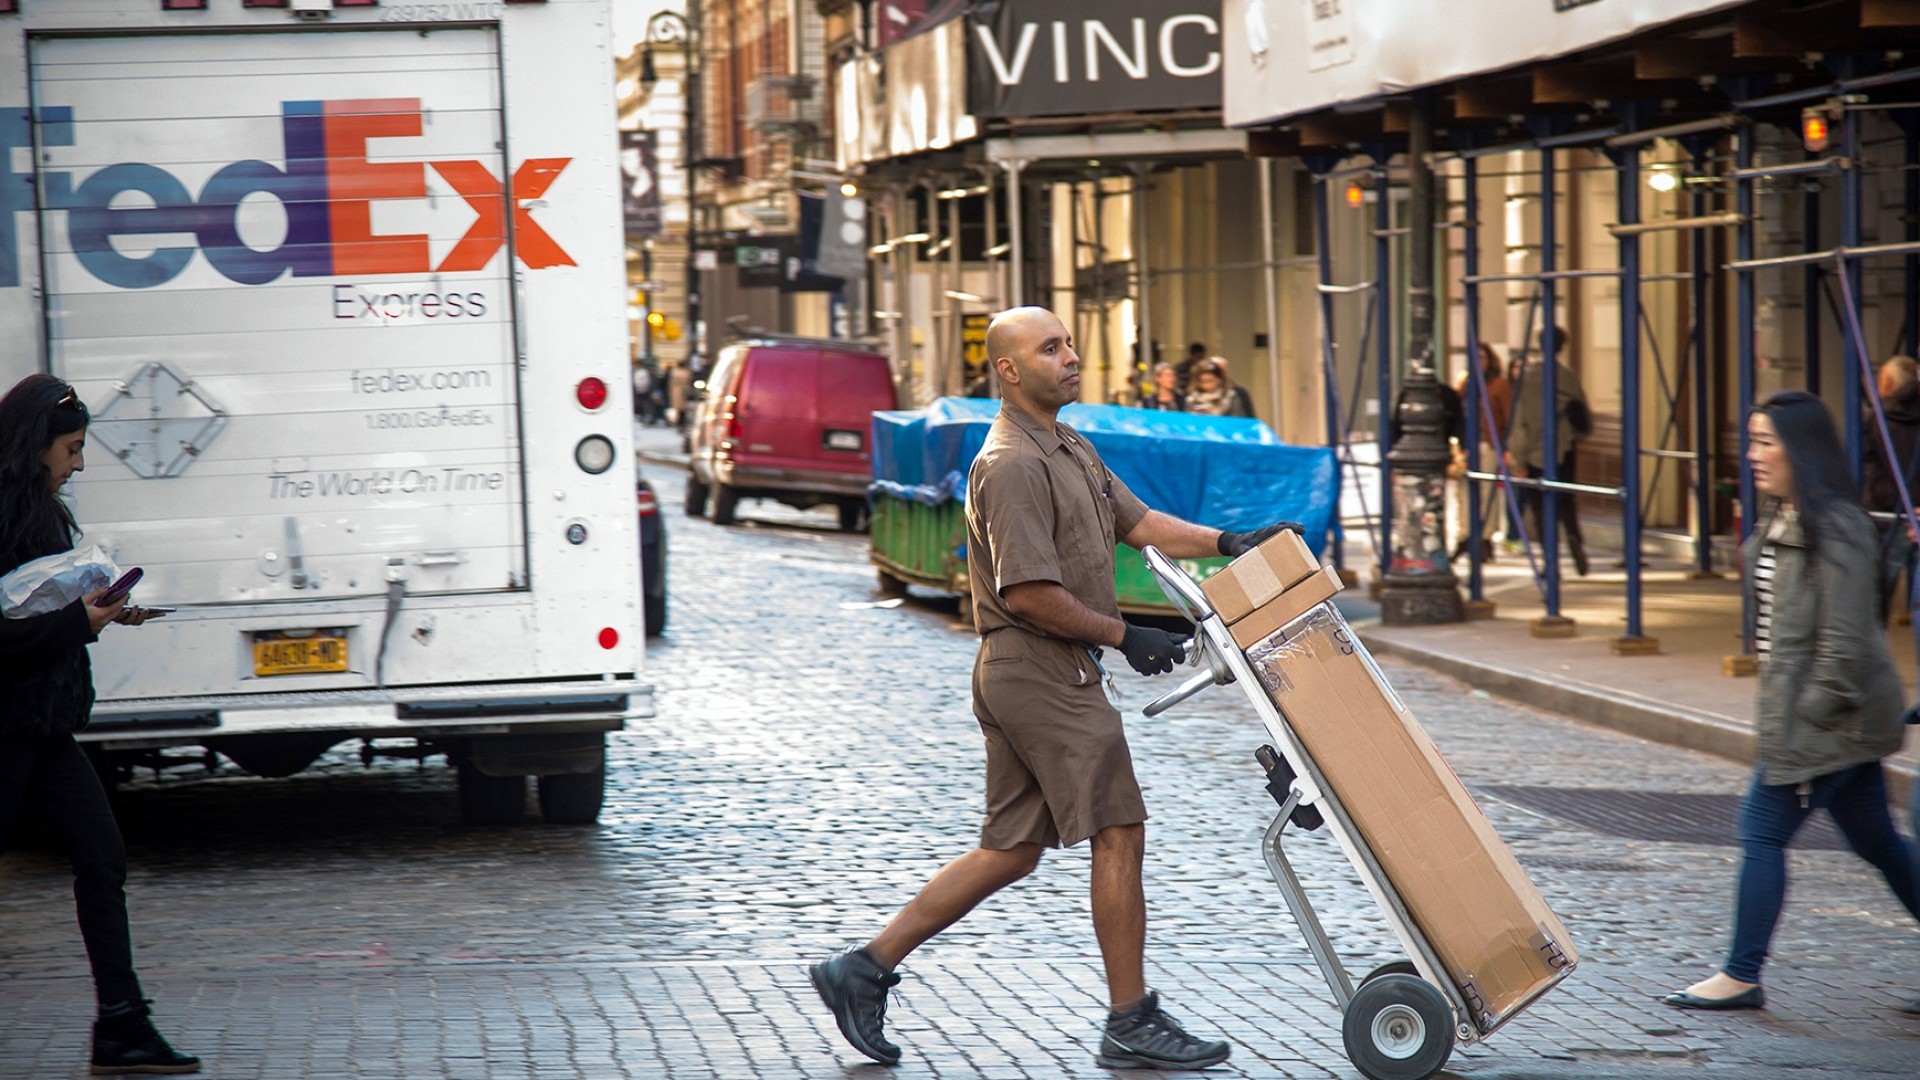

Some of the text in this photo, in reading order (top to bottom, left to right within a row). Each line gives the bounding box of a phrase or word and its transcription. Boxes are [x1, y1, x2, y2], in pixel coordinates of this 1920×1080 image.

[976, 13, 1221, 85] VINC
[332, 284, 487, 320] Express
[351, 369, 492, 394] fedex.com
[268, 468, 504, 498] The World On Time
